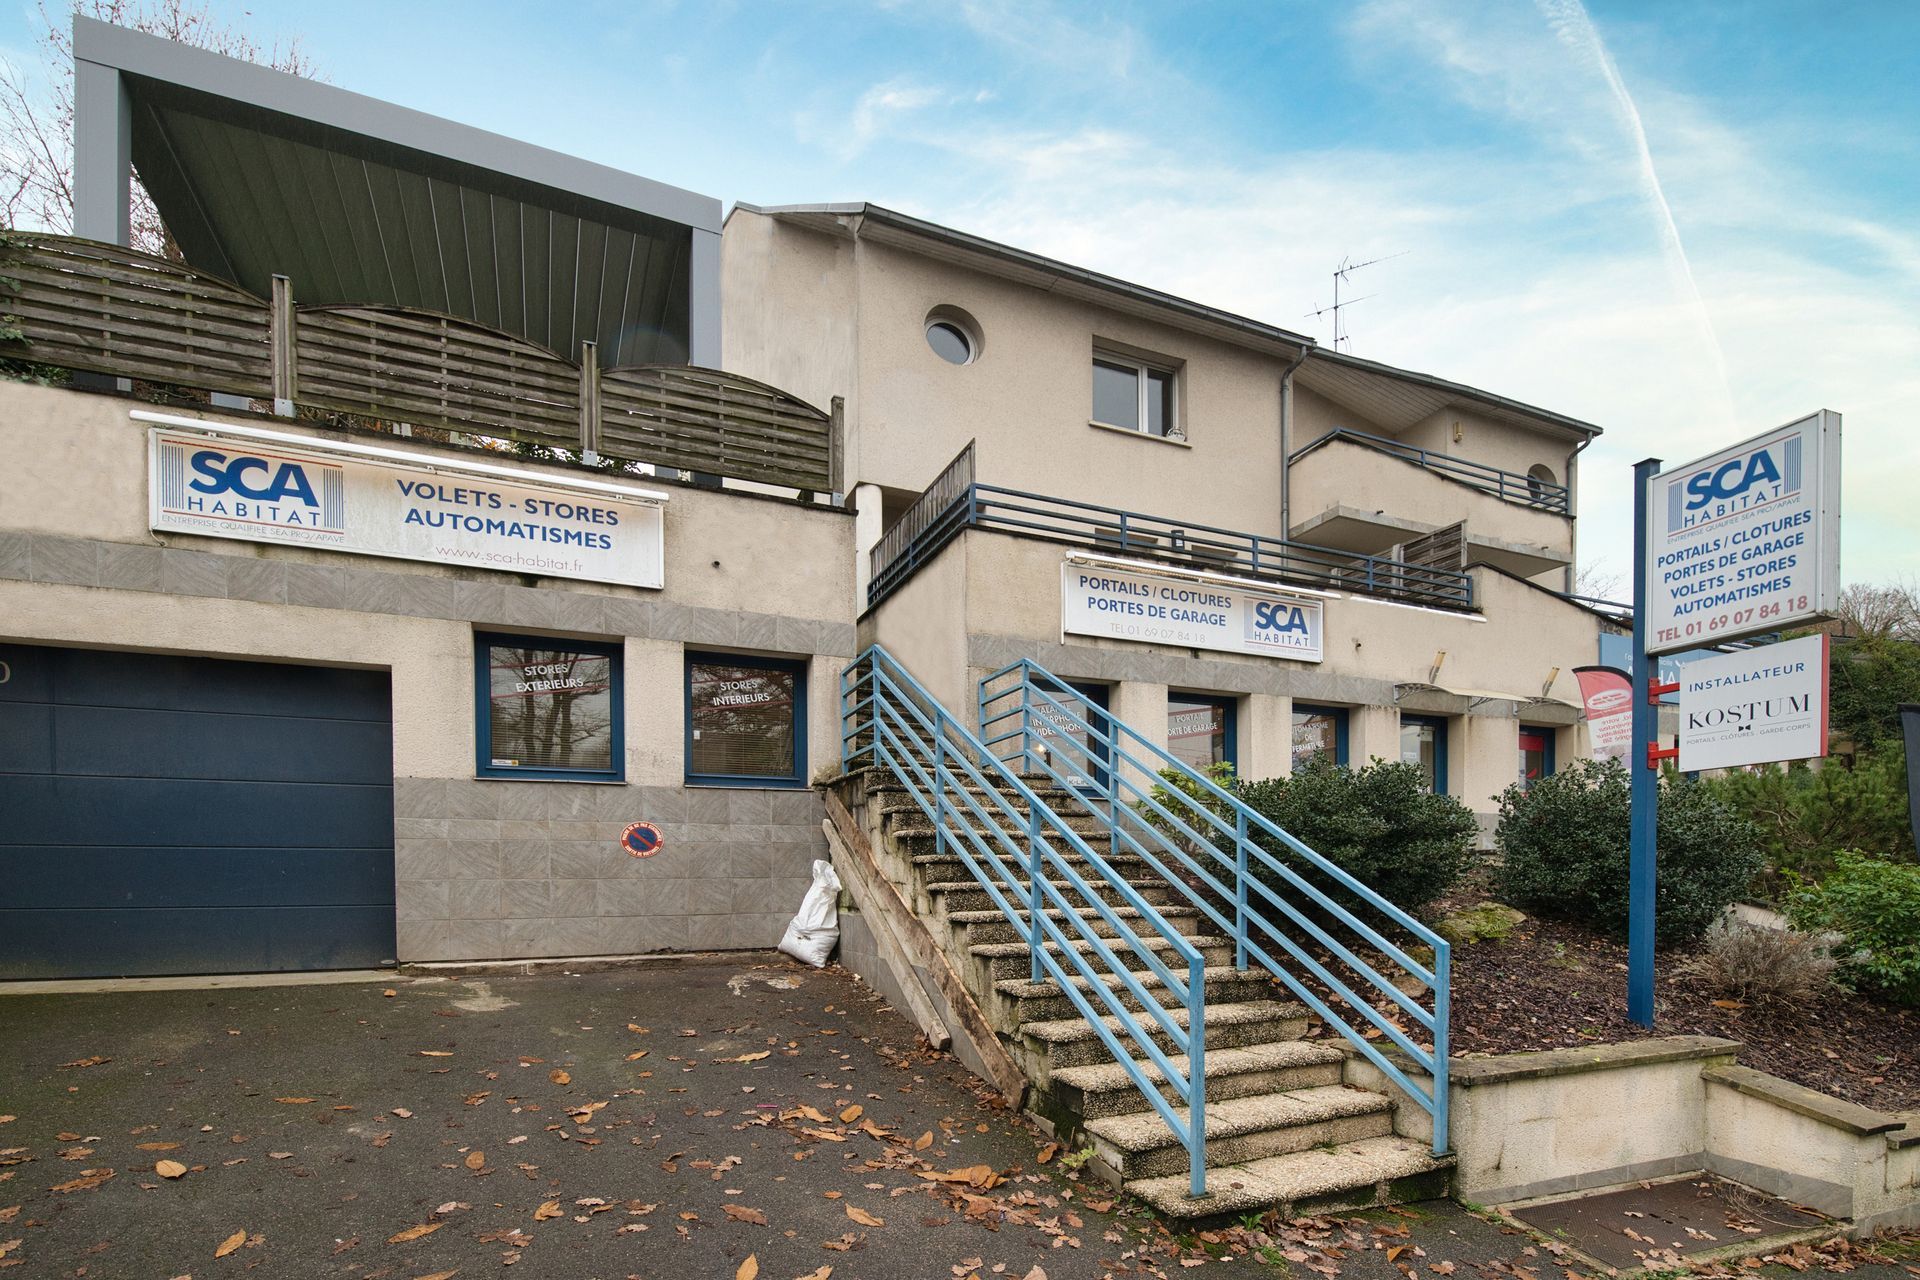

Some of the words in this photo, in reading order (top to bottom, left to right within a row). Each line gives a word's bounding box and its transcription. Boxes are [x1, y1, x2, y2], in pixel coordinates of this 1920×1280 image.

[189, 450, 319, 508] SCA
[1686, 450, 1781, 510] SCA
[188, 496, 320, 526] HABITAT
[397, 479, 502, 510] VOLETS
[525, 498, 619, 526] STORES
[1684, 484, 1782, 528] HABITAT
[162, 514, 218, 528] ENTREPRISE
[270, 528, 289, 536] SEA
[404, 508, 612, 550] AUTOMATISMES
[1658, 539, 1720, 568] PORTAILS
[1732, 510, 1811, 544] CLOTURES
[436, 546, 583, 572] www.sca-habitat.fr
[1664, 560, 1714, 584] PORTES
[1719, 552, 1737, 568] DE
[1742, 532, 1804, 560] GARAGE
[1080, 575, 1149, 597] PORTAILS
[1160, 588, 1232, 609] CLOTURES
[1671, 575, 1724, 599] VOLETS
[1737, 554, 1796, 581] STORES
[1088, 596, 1144, 616] PORTES
[1148, 605, 1166, 619] DE
[1171, 608, 1226, 626] GARAGE
[1674, 576, 1791, 616] AUTOMATISMES
[1111, 623, 1124, 633] TEL
[1128, 625, 1140, 635] 01
[1145, 627, 1158, 637] 69
[1160, 629, 1174, 639] 07
[1178, 631, 1190, 641] 84
[1195, 633, 1206, 643] 18
[1255, 602, 1308, 634] SCA
[1657, 626, 1681, 642] TEL
[1686, 621, 1702, 636] 01
[1709, 615, 1728, 630] 69
[1734, 608, 1754, 624] 07
[1760, 602, 1780, 618] 84
[1787, 596, 1808, 612] 18
[1254, 631, 1309, 647] HABITAT
[516, 678, 584, 692] EXTERIEURS
[524, 664, 568, 676] STORES
[720, 680, 758, 690] STORES
[1689, 662, 1804, 692] INSTALLATEUR
[712, 692, 770, 706] INTERIEURS
[1688, 693, 1811, 730] KOSTUM
[1168, 728, 1182, 736] ORTE
[1184, 726, 1191, 734] DE
[1192, 722, 1218, 732] GARAGE
[1687, 736, 1716, 745] PORTAILS
